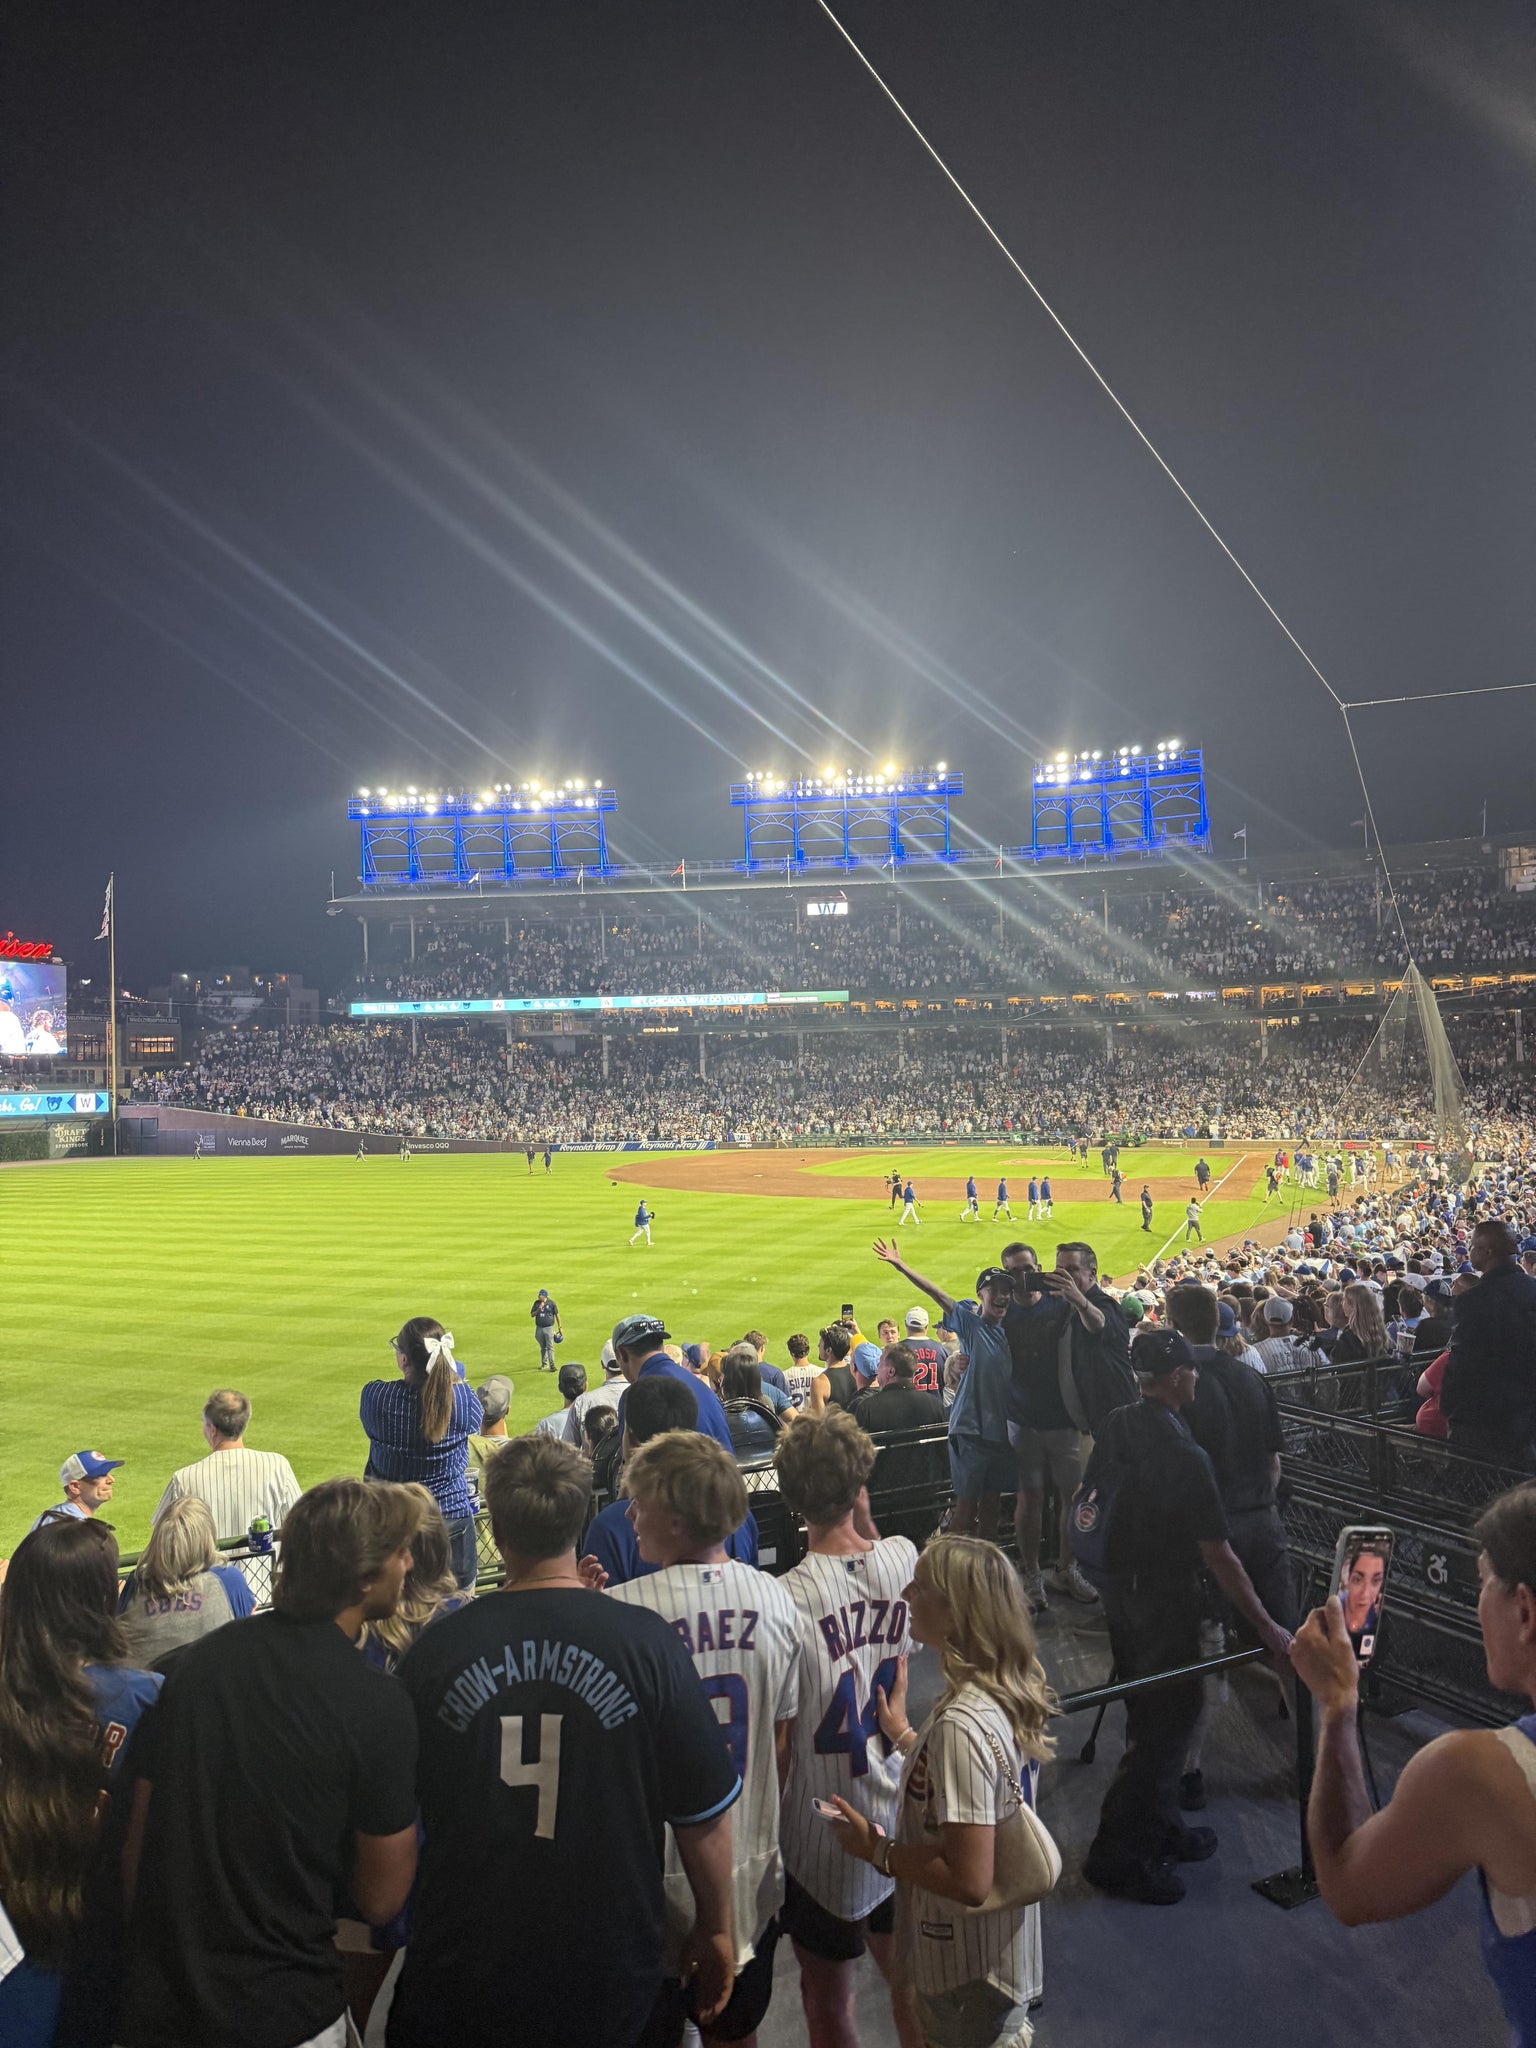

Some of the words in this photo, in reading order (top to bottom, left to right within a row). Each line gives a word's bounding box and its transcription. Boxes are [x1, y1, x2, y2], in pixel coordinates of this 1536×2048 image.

[816, 902, 837, 915] W
[20, 1097, 42, 1111] Go!
[81, 1097, 91, 1108] W
[59, 1135, 86, 1143] KINGS
[227, 1137, 251, 1146] Vienna
[251, 1138, 268, 1148] Beef
[280, 1134, 309, 1146] MARQUEE
[639, 1141, 675, 1150] Reynolds
[559, 1143, 594, 1152] Reynolds
[594, 1143, 616, 1152] Wrap
[789, 1376, 814, 1390] SUZU
[913, 1363, 939, 1390] 21
[818, 1600, 908, 1663] RIZZO
[436, 1639, 639, 1733] CROW-ARMSTRONG
[499, 1712, 564, 1840] 4
